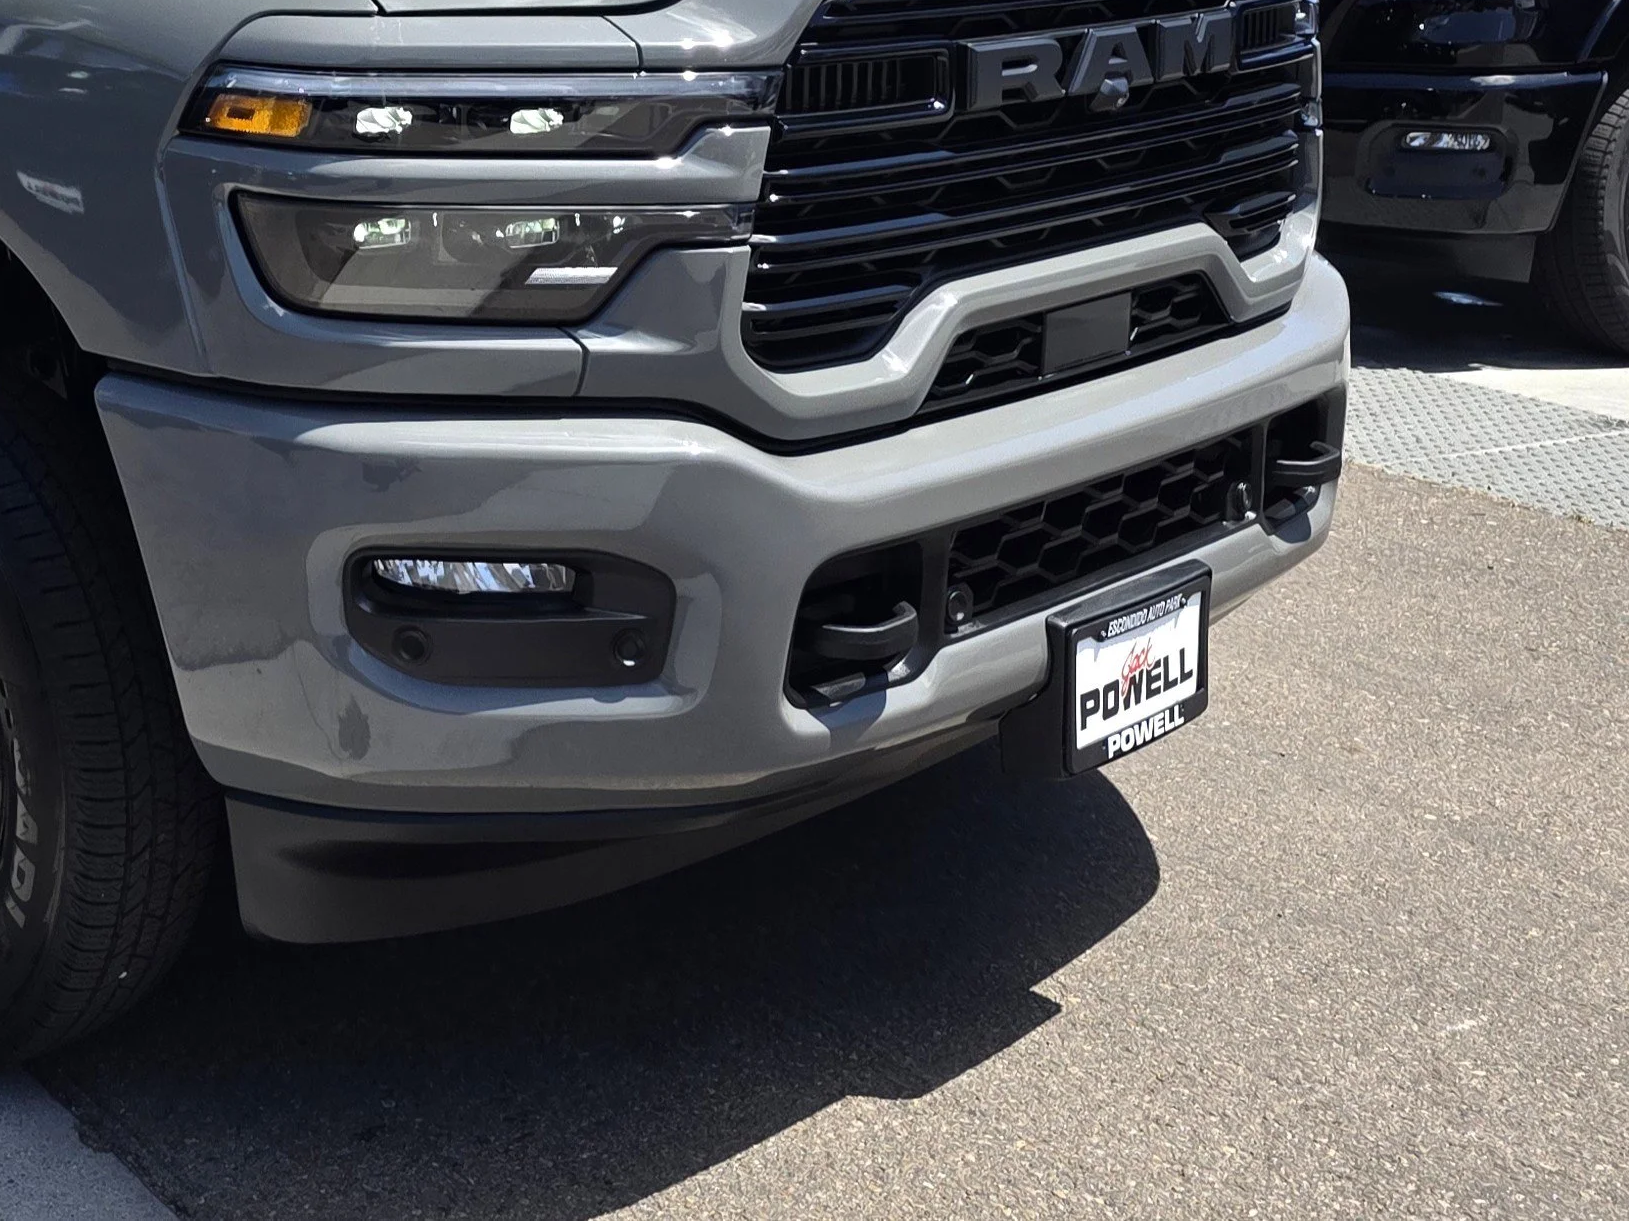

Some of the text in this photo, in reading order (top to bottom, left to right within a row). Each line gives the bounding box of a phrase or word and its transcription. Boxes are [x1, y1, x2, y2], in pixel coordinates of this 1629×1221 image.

[967, 10, 1234, 110] RAM
[1107, 593, 1182, 638] ESCONDIDO AUTO PARK
[1080, 647, 1194, 732] POWELL
[1121, 637, 1155, 698] Jack
[1107, 704, 1185, 760] POWELL
